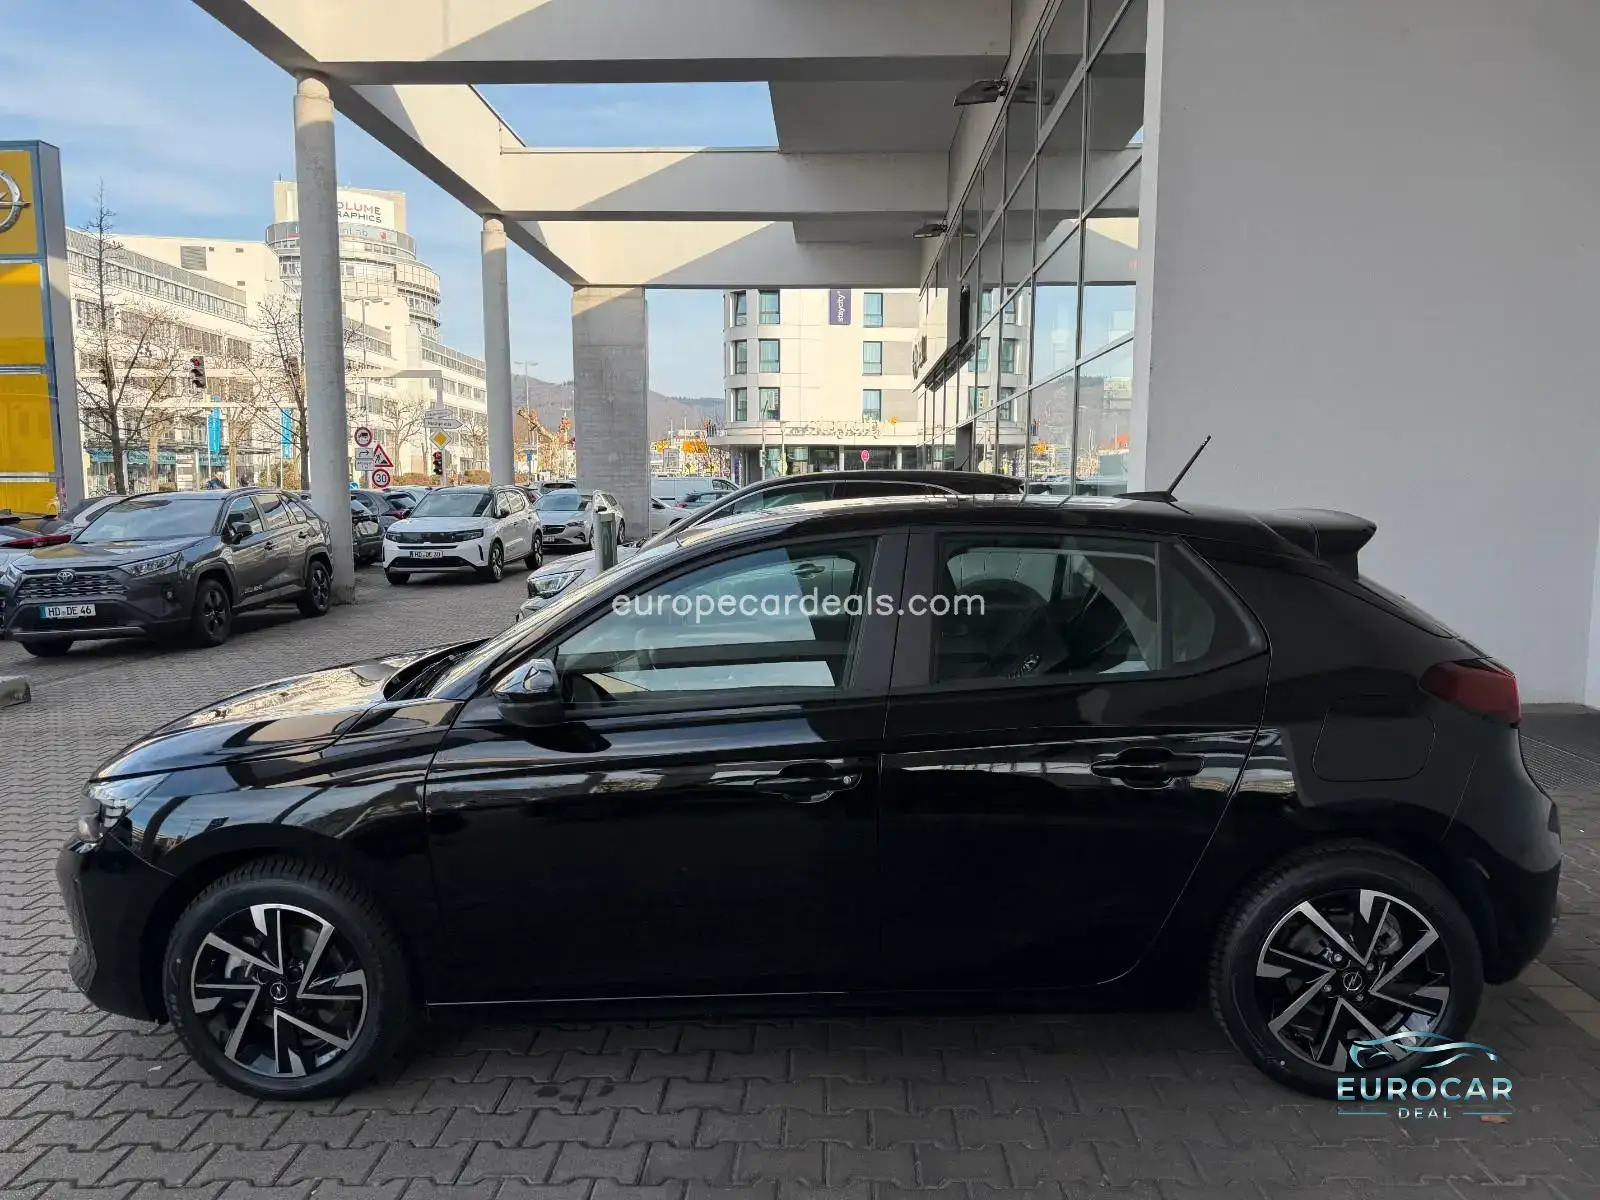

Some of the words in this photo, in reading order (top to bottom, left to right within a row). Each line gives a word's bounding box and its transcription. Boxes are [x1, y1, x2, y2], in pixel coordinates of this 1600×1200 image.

[337, 201, 381, 215] OLUME
[337, 211, 382, 224] RAPHICS
[376, 474, 387, 483] 30
[48, 607, 61, 616] HD
[66, 606, 78, 616] DE
[80, 605, 92, 615] 46
